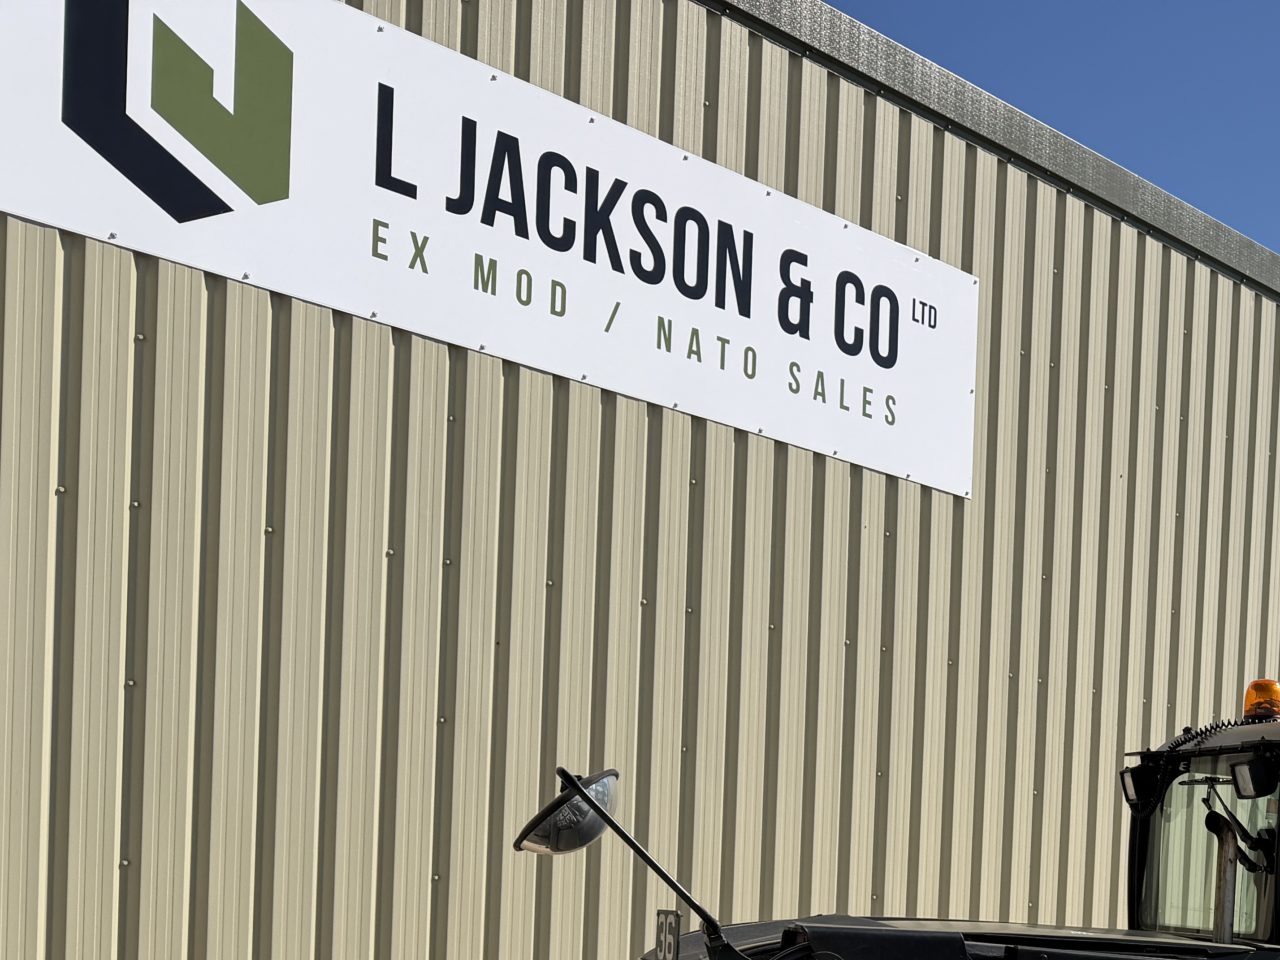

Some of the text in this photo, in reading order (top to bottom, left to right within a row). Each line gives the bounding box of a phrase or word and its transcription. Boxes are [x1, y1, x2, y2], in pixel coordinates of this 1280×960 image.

[371, 219, 898, 428] EX MOD / NATO SALES
[374, 82, 938, 370] L JACKSON & CO LTD
